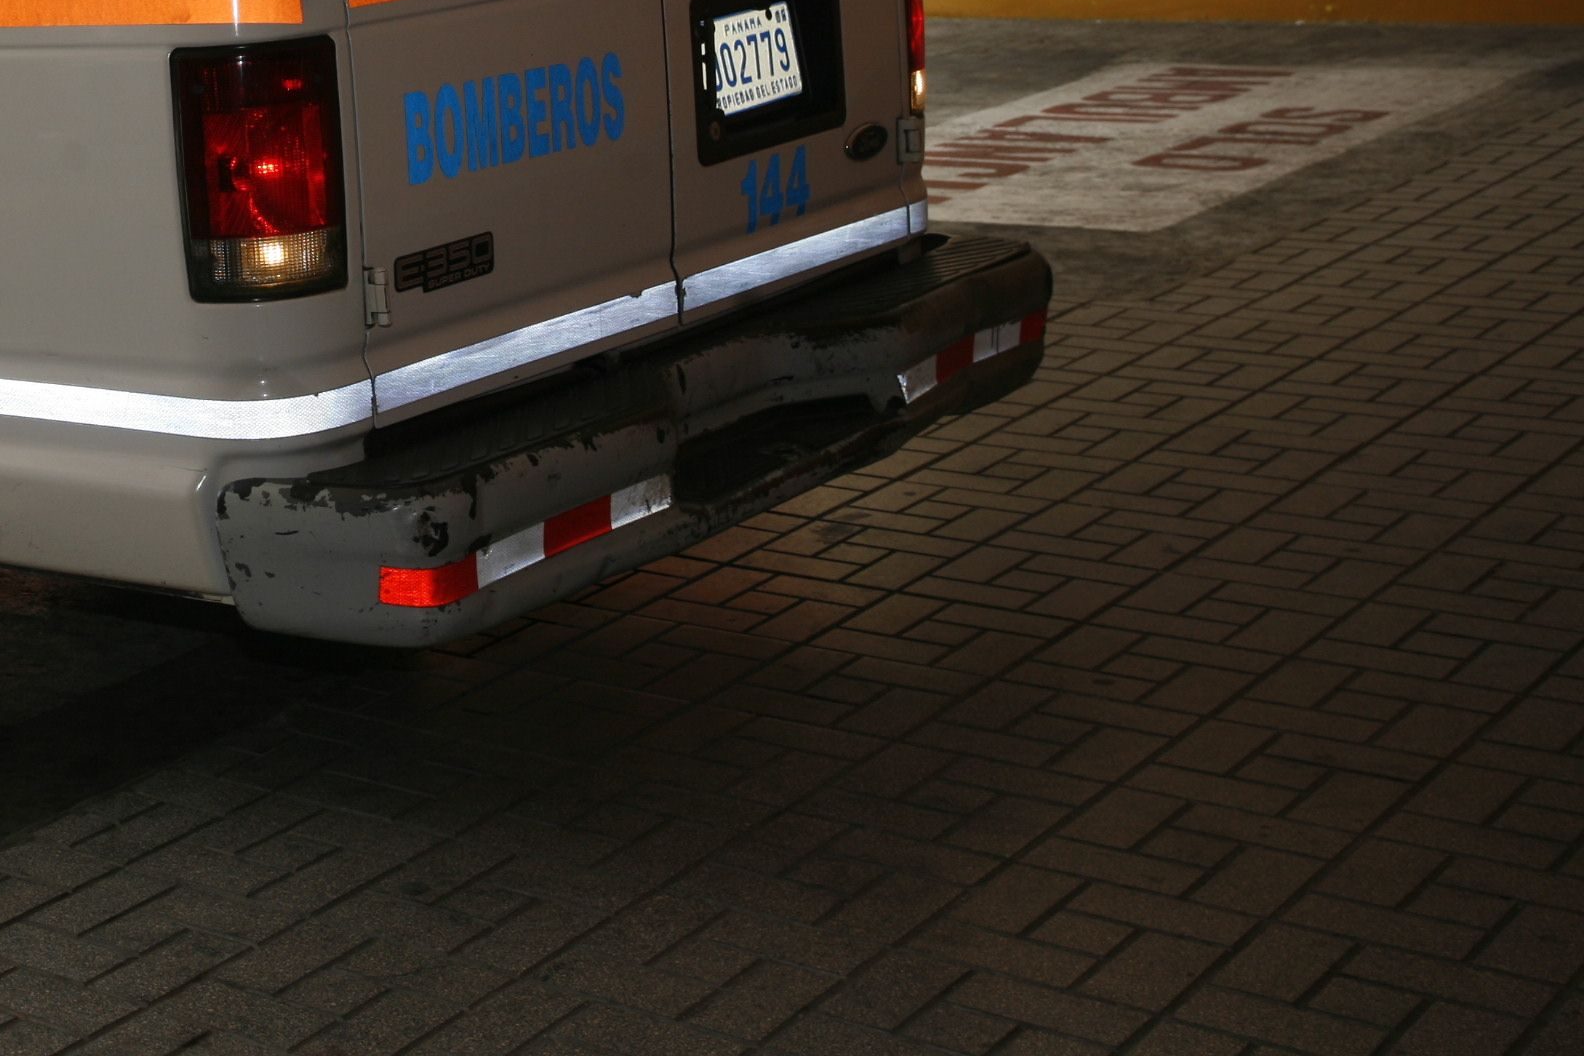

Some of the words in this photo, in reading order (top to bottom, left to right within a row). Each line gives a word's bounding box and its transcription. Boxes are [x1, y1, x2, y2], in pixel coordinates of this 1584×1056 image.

[724, 16, 762, 36] PANAMA
[403, 52, 625, 186] BOMBEROS
[716, 88, 755, 110] ROPIEDAD
[756, 83, 771, 100] DEL
[771, 75, 798, 95] ESTADO
[924, 66, 1296, 205] AMBULANCI
[1130, 106, 1395, 172] SOLO
[739, 144, 812, 235] 144
[463, 262, 490, 279] DUTY
